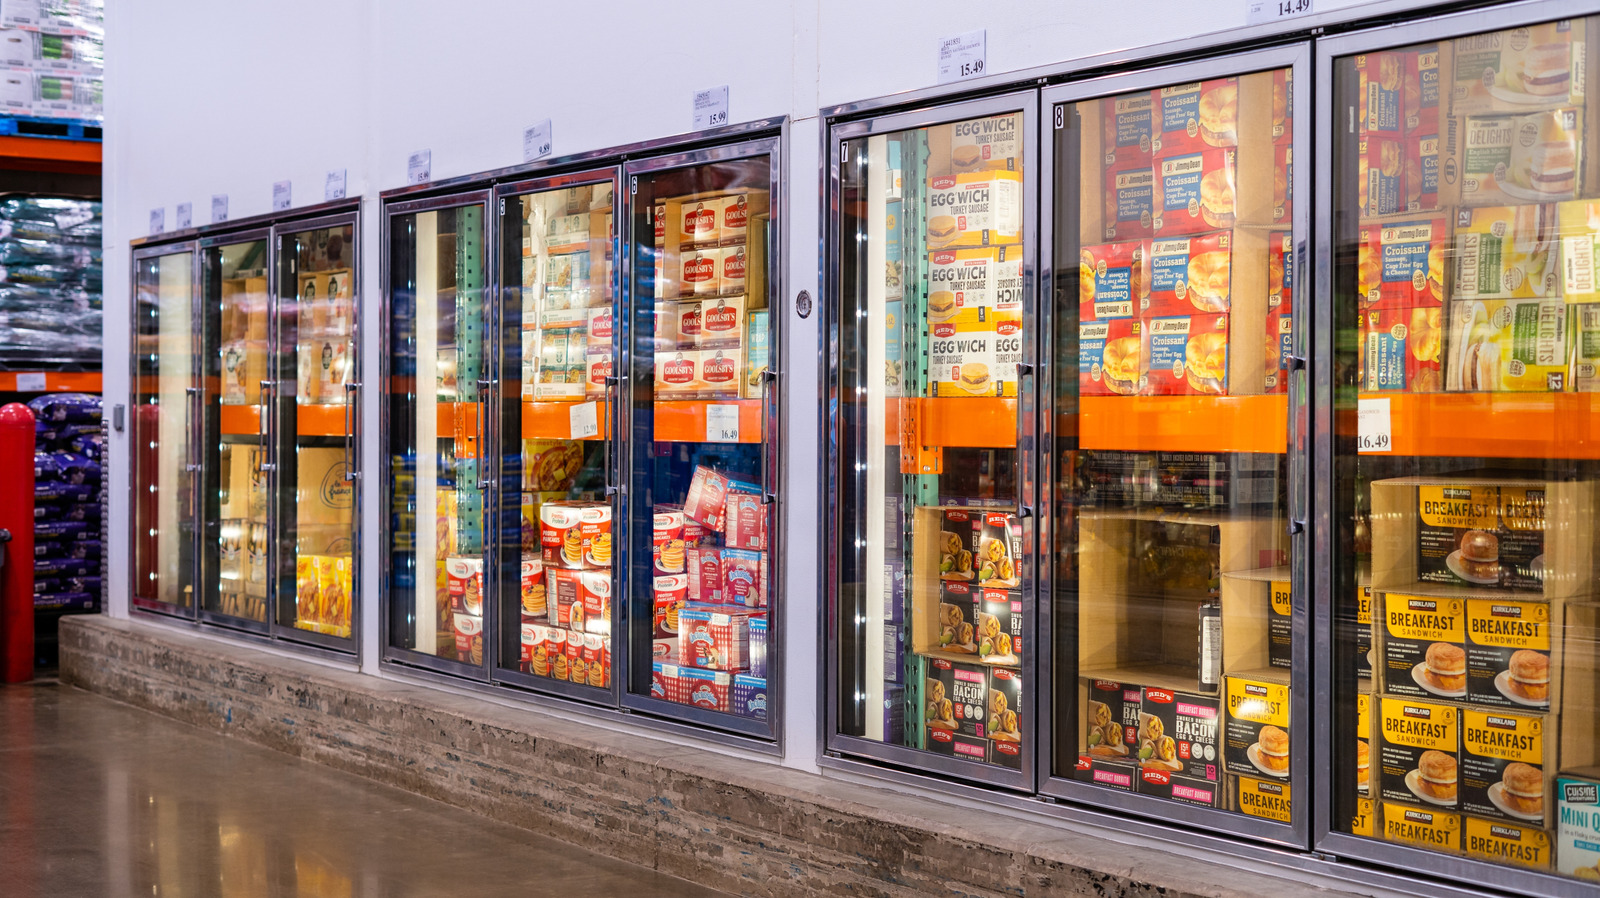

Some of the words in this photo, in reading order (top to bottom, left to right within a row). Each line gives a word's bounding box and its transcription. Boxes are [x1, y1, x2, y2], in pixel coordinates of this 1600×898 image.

[1279, 0, 1309, 16] 14.49
[1357, 55, 1366, 64] 12
[960, 60, 984, 77] 15.49
[1164, 95, 1197, 108] Croissant
[709, 111, 726, 125] 15.99
[1056, 106, 1063, 127] 8
[1118, 112, 1150, 124] Croissant
[1563, 112, 1574, 123] 12
[975, 134, 993, 145] TURKEY
[993, 131, 1015, 142] SAUSAGE
[1446, 119, 1457, 155] Jimmy
[1470, 128, 1512, 145] DELIGHTS
[842, 143, 848, 161] 7
[1469, 149, 1490, 157] English
[1175, 161, 1190, 171] Jimmy
[1189, 160, 1200, 168] Dean
[632, 177, 637, 193] 6
[1166, 175, 1199, 187] Croissant
[1119, 188, 1151, 199] Croissant
[950, 206, 967, 216] TURKEY
[968, 203, 989, 213] SAUSAGE
[686, 214, 714, 226] GOOLSBY'S
[1459, 211, 1467, 225] 12
[1398, 229, 1415, 239] Jimmy
[1415, 229, 1429, 237] Dean
[1219, 236, 1228, 244] 12
[1385, 245, 1426, 256] Croissant
[1153, 257, 1186, 268] Croissant
[1462, 234, 1477, 291] DELIGHTS
[1574, 239, 1591, 290] DELIGHTS
[685, 263, 714, 274] GOOLSBY'S
[950, 281, 966, 291] TURKEY
[966, 280, 986, 290] SAUSAGE
[1097, 290, 1128, 300] Croissant
[707, 312, 736, 322] GOOLSBY'S
[1370, 312, 1377, 322] 12
[1132, 322, 1140, 331] 12
[1163, 322, 1176, 331] Jimmy
[1176, 321, 1188, 330] Dean
[1539, 305, 1557, 362] DELIGHTS
[1152, 336, 1185, 346] Croissant
[665, 366, 693, 375] GOOLSBY'S
[704, 364, 733, 374] GOOLSBY'S
[1551, 374, 1562, 389] 12
[721, 429, 738, 440] 16.49
[1358, 434, 1389, 449] 16.49
[1443, 488, 1471, 497] KIRKLAND
[1424, 501, 1488, 518] BREAKFAST
[1436, 516, 1478, 527] SANDWICH
[1409, 600, 1436, 608] KIRKLAND
[1492, 606, 1521, 614] KIRKLAND
[1391, 612, 1454, 630] BREAKFAST
[1402, 628, 1443, 638] SANDWICH
[1472, 618, 1540, 637] BREAKFAST
[1484, 635, 1527, 645] SANDWICH
[953, 685, 984, 700] BACON
[1246, 685, 1267, 694] KIRKLAND
[1148, 691, 1172, 702] RED'S
[1178, 704, 1198, 715] BREAKFAST
[1198, 708, 1215, 718] BURRITO
[1231, 695, 1281, 716] BREAKFAST
[1404, 707, 1430, 716] KIRKLAND
[1487, 717, 1516, 727] KIRKLAND
[1533, 722, 1538, 730] 8
[1176, 720, 1216, 739] BACON
[1386, 717, 1448, 739] BREAKFAST
[1195, 736, 1215, 745] CHEESE
[1396, 734, 1436, 747] SANDWICH
[1467, 728, 1535, 751] BREAKFAST
[1479, 745, 1522, 759] SANDWICH
[1207, 765, 1215, 773] 10
[1095, 771, 1113, 782] BREAKFAST
[1114, 774, 1129, 785] BURRITO
[1145, 771, 1168, 783] RED'S
[1173, 785, 1194, 798] BREAKFAST
[1194, 789, 1211, 801] BURRITO
[1258, 782, 1282, 793] KIRKLAND
[1567, 786, 1596, 797] CUISINE
[1253, 808, 1289, 820] SANDWICH
[1405, 810, 1432, 822] KIRKLAND
[1561, 806, 1588, 828] MINI
[1449, 817, 1453, 825] 8
[1388, 820, 1451, 845] BREAKFAST
[1491, 826, 1521, 837] KIRKLAND
[1539, 833, 1544, 841] 8
[1574, 830, 1588, 840] flaky
[1471, 836, 1540, 862] BREAKFAST
